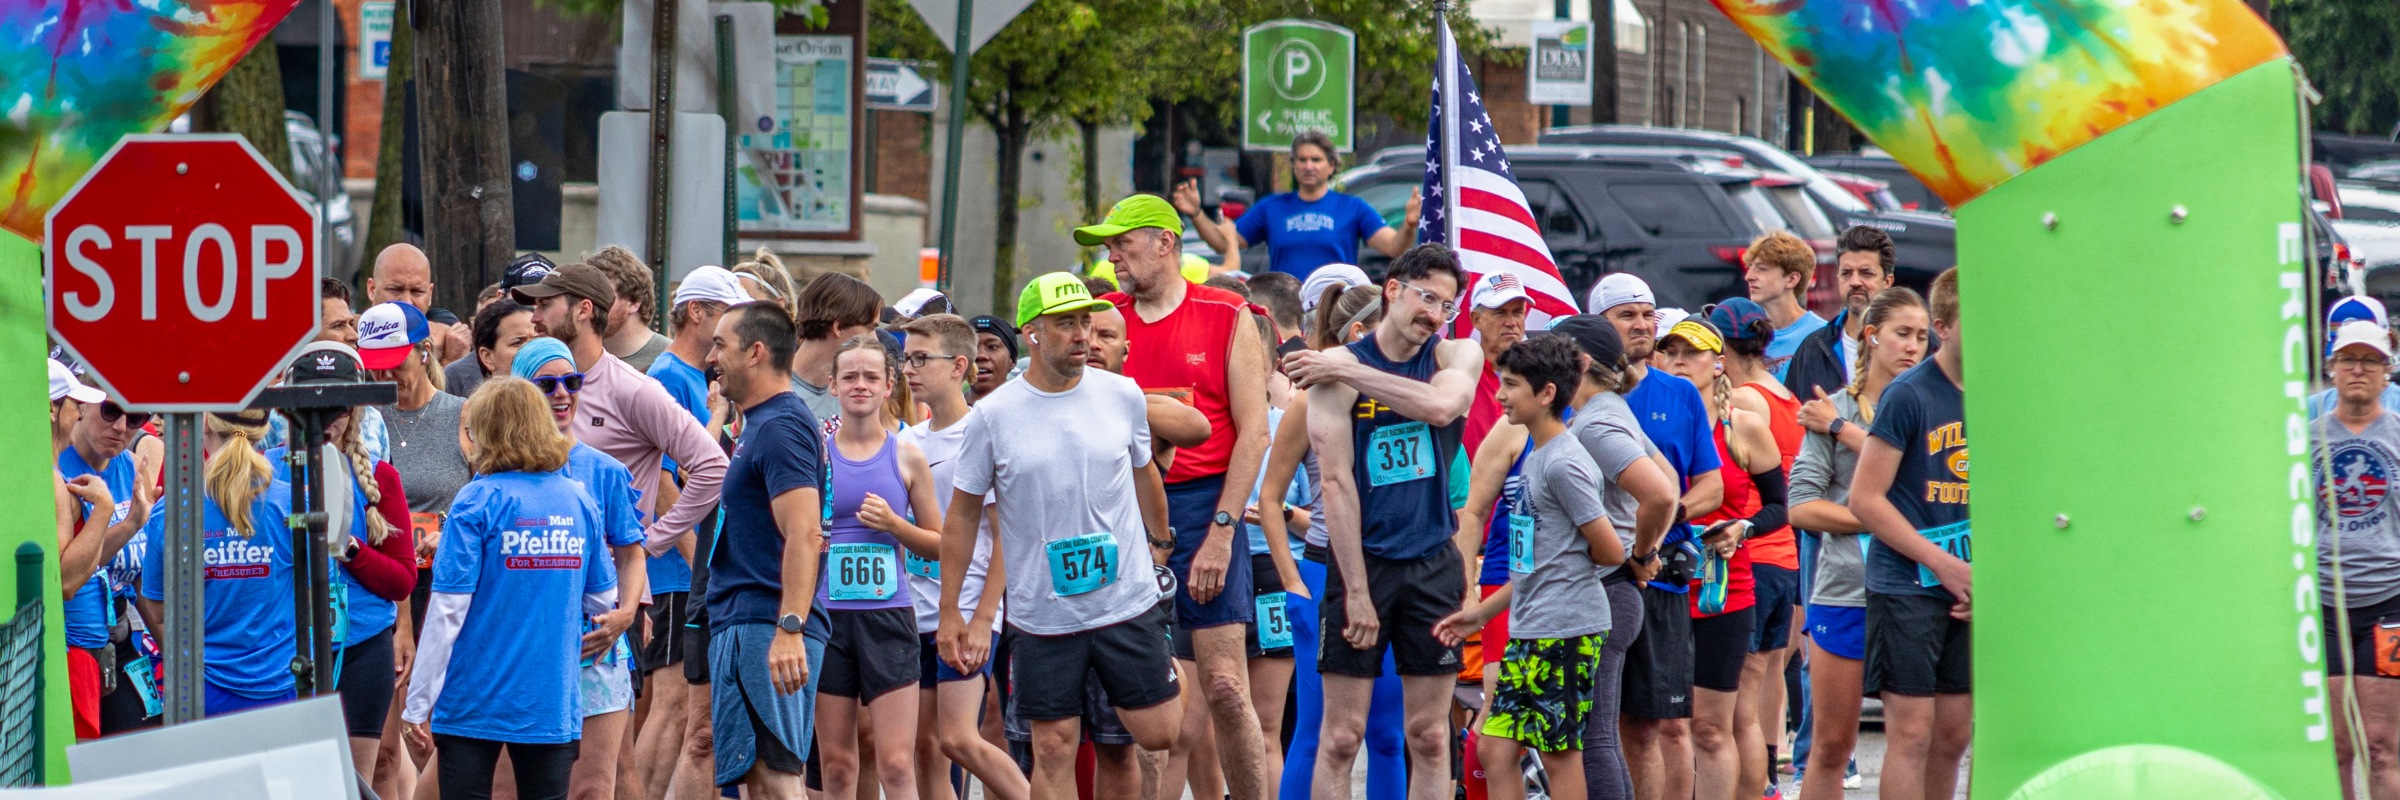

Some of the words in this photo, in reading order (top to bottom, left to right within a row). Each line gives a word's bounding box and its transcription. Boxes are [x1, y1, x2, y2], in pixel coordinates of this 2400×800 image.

[796, 40, 843, 56] Orion
[1541, 46, 1582, 67] DDA
[1285, 50, 1311, 90] P
[1283, 109, 1333, 122] PUBLIC
[63, 223, 304, 322] STOP
[360, 320, 400, 338] Merica
[316, 363, 336, 371] adidas
[1928, 421, 1967, 456] WIL
[1377, 436, 1420, 471] 337
[1926, 481, 1971, 504] FOOT
[549, 516, 574, 526] Matt
[204, 541, 274, 565] eiffer
[501, 530, 586, 555] Pfeiffer
[840, 556, 886, 586] 666
[1062, 545, 1108, 581] 574
